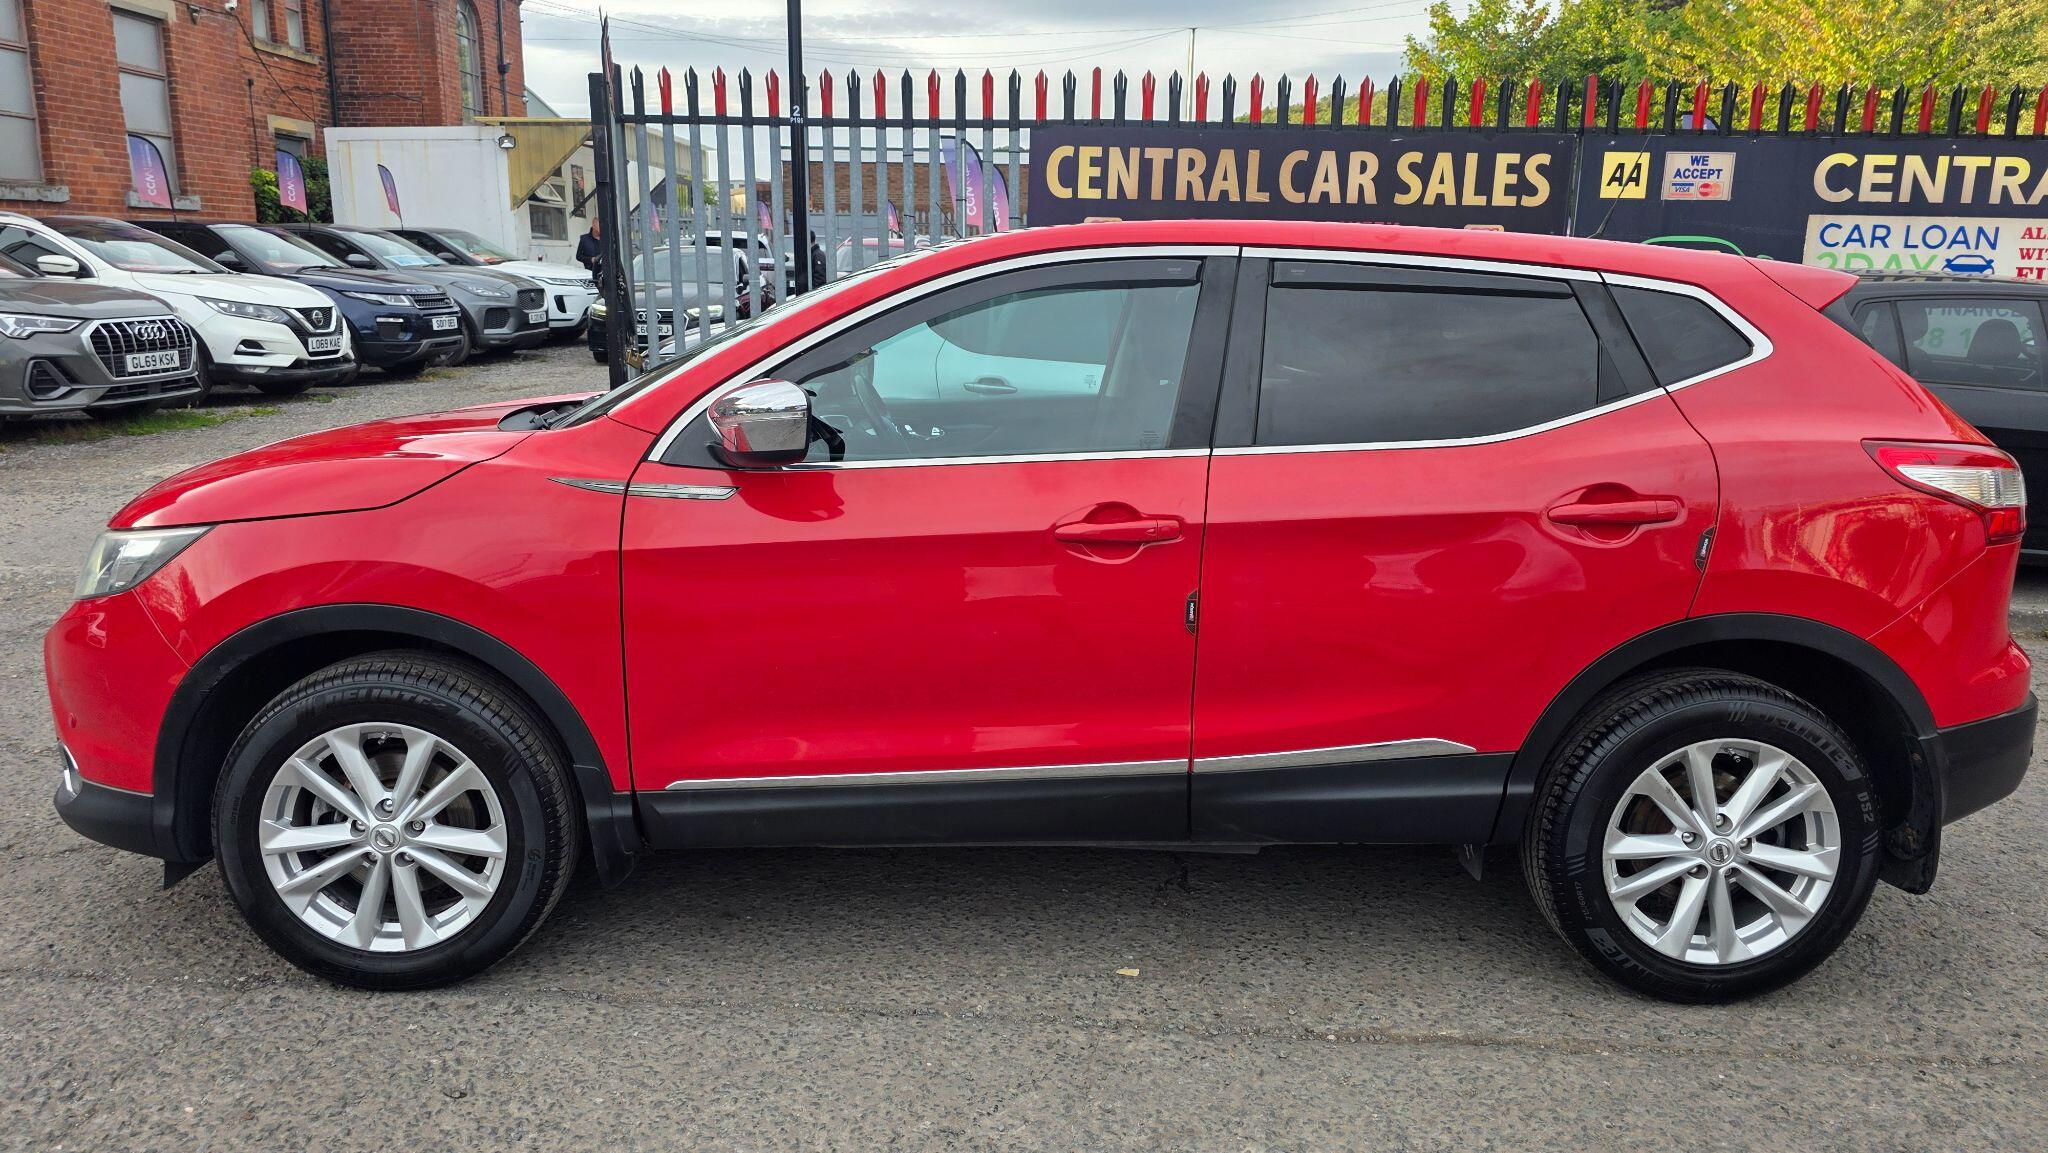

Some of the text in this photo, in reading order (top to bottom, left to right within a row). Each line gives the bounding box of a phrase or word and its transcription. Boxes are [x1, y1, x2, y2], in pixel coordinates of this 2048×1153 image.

[793, 105, 800, 117] 2
[1690, 155, 1710, 167] WE
[1046, 145, 1552, 207] CENTRAL CAR SALES
[1606, 162, 1643, 187] AA
[1673, 168, 1723, 180] ACCEPT
[1819, 222, 2000, 251] CAR LOAN
[2020, 226, 2048, 241] AL
[131, 353, 176, 369] GL69 KSK
